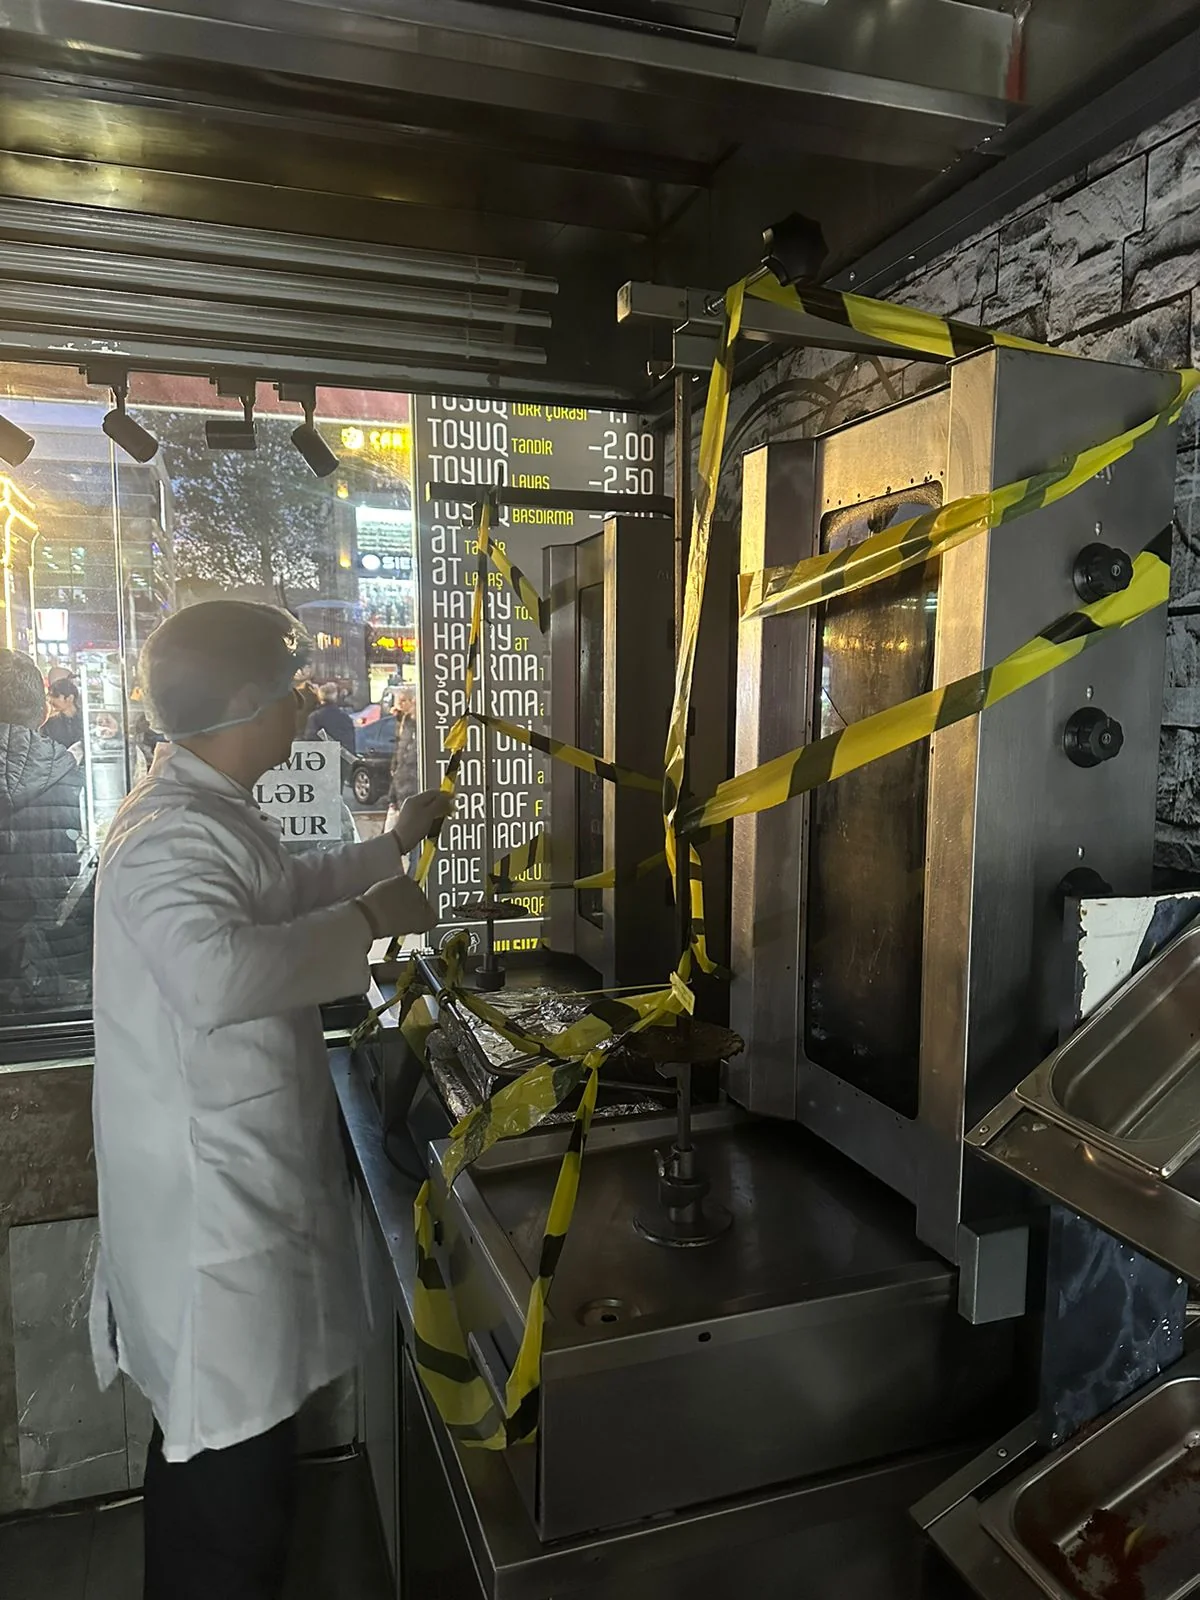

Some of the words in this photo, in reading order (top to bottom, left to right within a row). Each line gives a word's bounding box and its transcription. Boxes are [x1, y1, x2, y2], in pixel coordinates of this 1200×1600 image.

[427, 418, 509, 458] TOYUQ
[512, 508, 575, 527] BASDIRMA
[464, 571, 504, 591] LAAŞ
[256, 783, 315, 804] LƏB
[449, 791, 529, 820] ARTOF
[438, 853, 481, 885] PİDE
